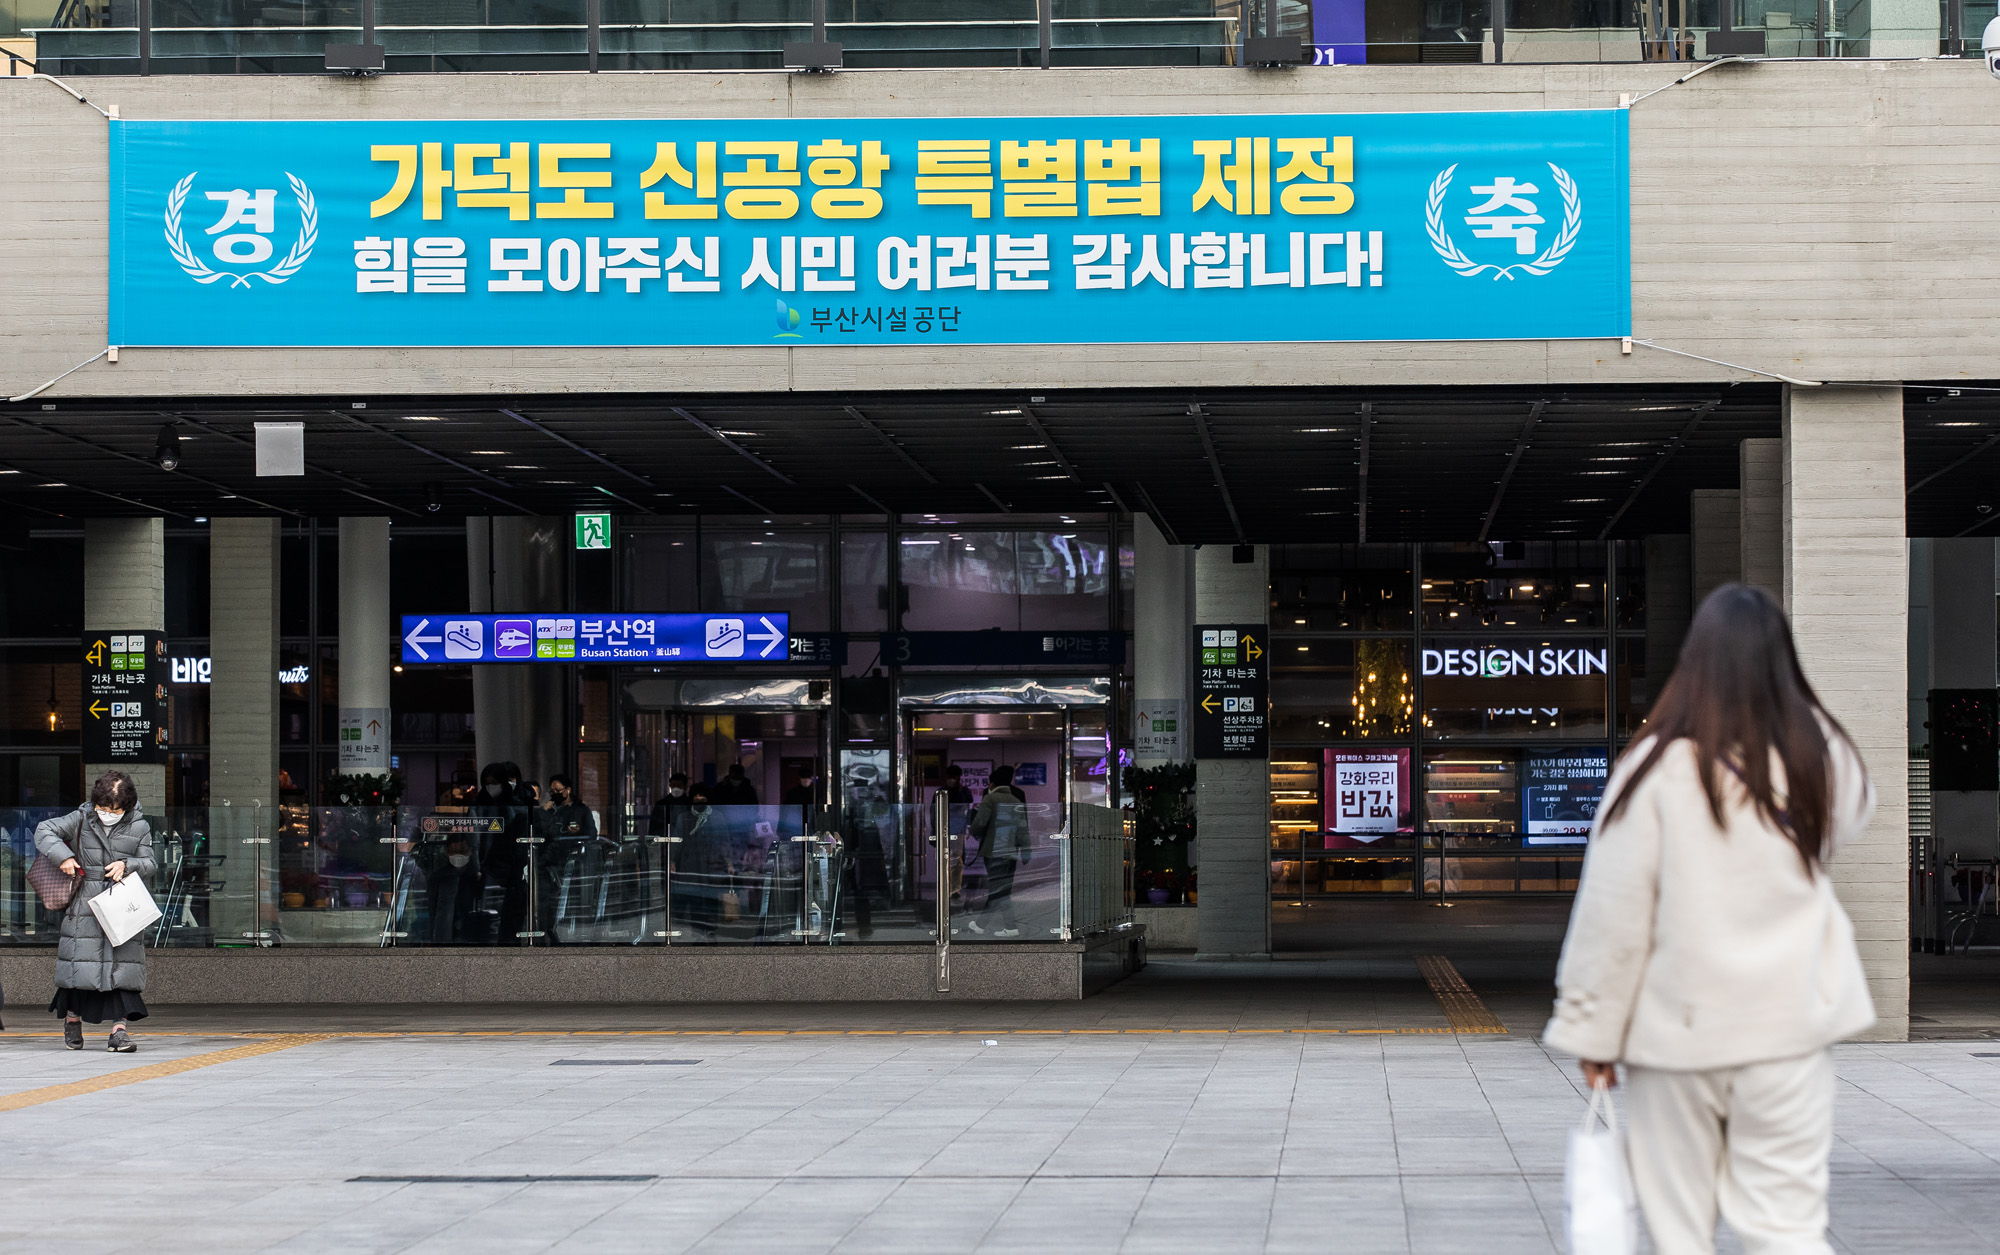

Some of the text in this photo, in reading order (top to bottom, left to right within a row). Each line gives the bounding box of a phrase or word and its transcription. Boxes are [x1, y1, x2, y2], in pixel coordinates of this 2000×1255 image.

[370, 136, 1355, 221] 가덕도 신공항 특별법 제정
[1464, 176, 1546, 256] 축
[204, 188, 278, 264] 경
[353, 231, 1384, 294] 힘을 모아주신 시민 여러분 감사합니다!
[810, 306, 962, 334] 부산시설공단
[580, 618, 655, 646] 부산역
[790, 638, 814, 652] 가는
[896, 636, 910, 661] 3
[1043, 637, 1109, 651] 들어가는 곳
[581, 649, 611, 657] Busan
[613, 648, 649, 657] Station
[1422, 649, 1607, 676] DESIGN SKIN
[91, 674, 145, 684] 기차 타는곳
[279, 665, 309, 683] nuts
[1202, 668, 1256, 678] 기차 타는곳
[111, 720, 150, 729] 선상주차장
[1223, 716, 1263, 724] 선상주차장
[1154, 736, 1177, 744] 타는곳
[341, 745, 380, 753] 기차 타는곳
[1530, 759, 1555, 767] KTX가
[962, 768, 989, 776] 동킥보드
[1340, 772, 1394, 785] 강화유리
[1531, 769, 1547, 778] 가는
[1342, 790, 1394, 818] 반값
